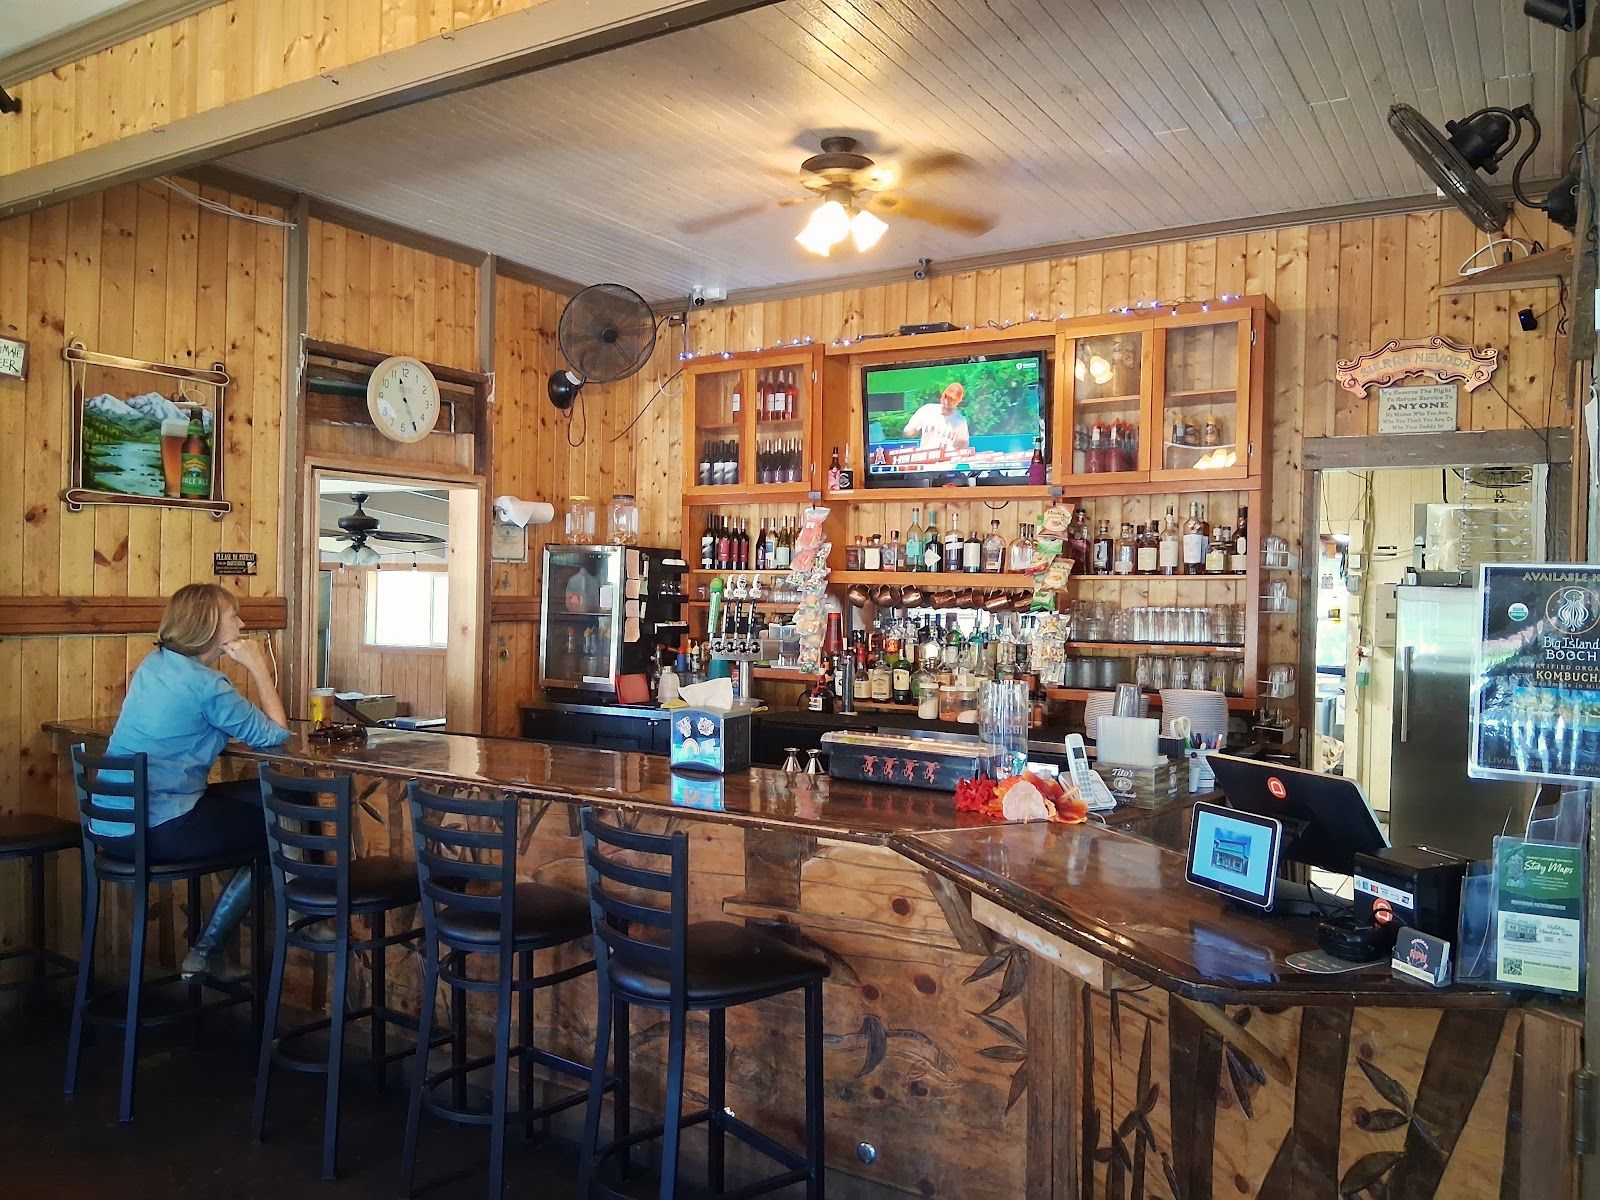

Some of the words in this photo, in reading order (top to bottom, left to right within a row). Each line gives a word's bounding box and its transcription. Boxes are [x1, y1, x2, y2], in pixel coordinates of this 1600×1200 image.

[1415, 352, 1472, 370] NEVADA
[391, 370, 397, 379] 11
[402, 368, 410, 378] 12
[382, 379, 390, 389] 10
[422, 385, 427, 394] 2
[1387, 401, 1449, 411] ANYONE
[400, 422, 406, 432] 6
[215, 553, 233, 561] PLEASE
[232, 553, 239, 561] BE
[1522, 571, 1588, 582] AVAILABLE
[1542, 635, 1561, 650] Big
[1561, 635, 1600, 650] Island
[1545, 648, 1597, 661] BOOCH
[1535, 670, 1600, 683] KOMBUCH
[1111, 767, 1135, 777] Tito's
[1523, 859, 1547, 875] Story
[1547, 861, 1574, 876] Maps
